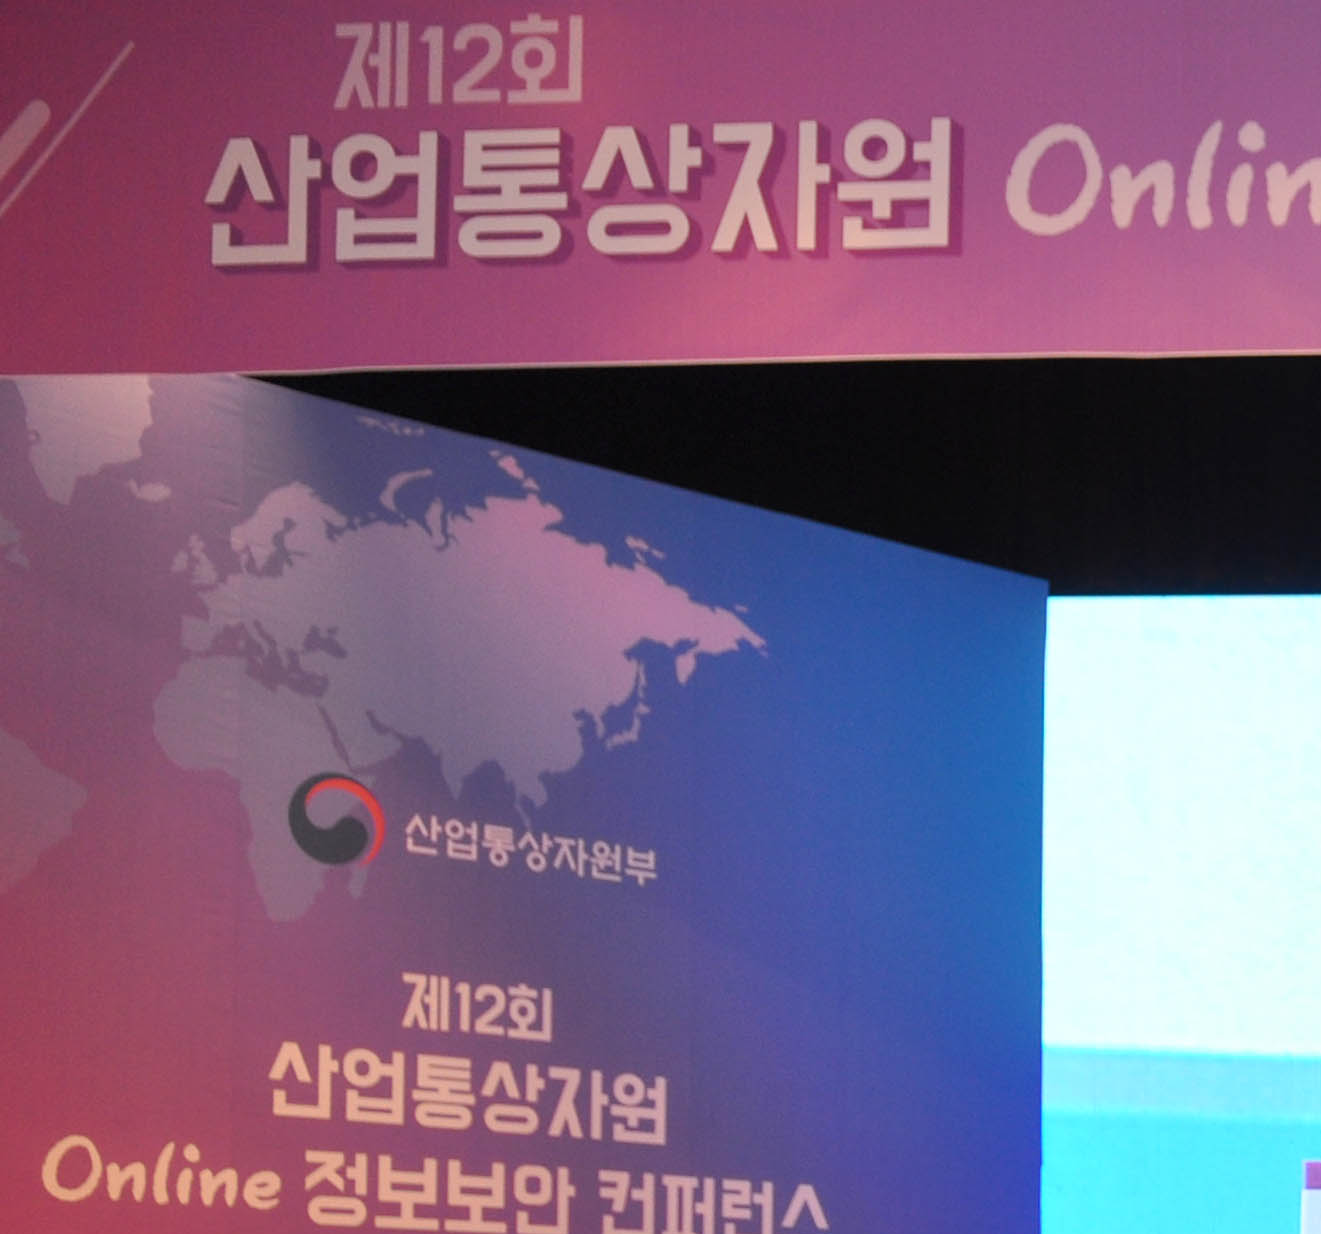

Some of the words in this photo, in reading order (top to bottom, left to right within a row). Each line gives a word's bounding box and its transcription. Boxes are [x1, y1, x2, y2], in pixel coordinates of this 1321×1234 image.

[333, 14, 583, 108] 제12회
[205, 116, 954, 268] 산업통상자원
[404, 812, 659, 886] 산업통상자원부
[401, 972, 554, 1043] 제12회
[269, 1041, 668, 1146] 산업통상자원
[41, 1134, 282, 1210] Online
